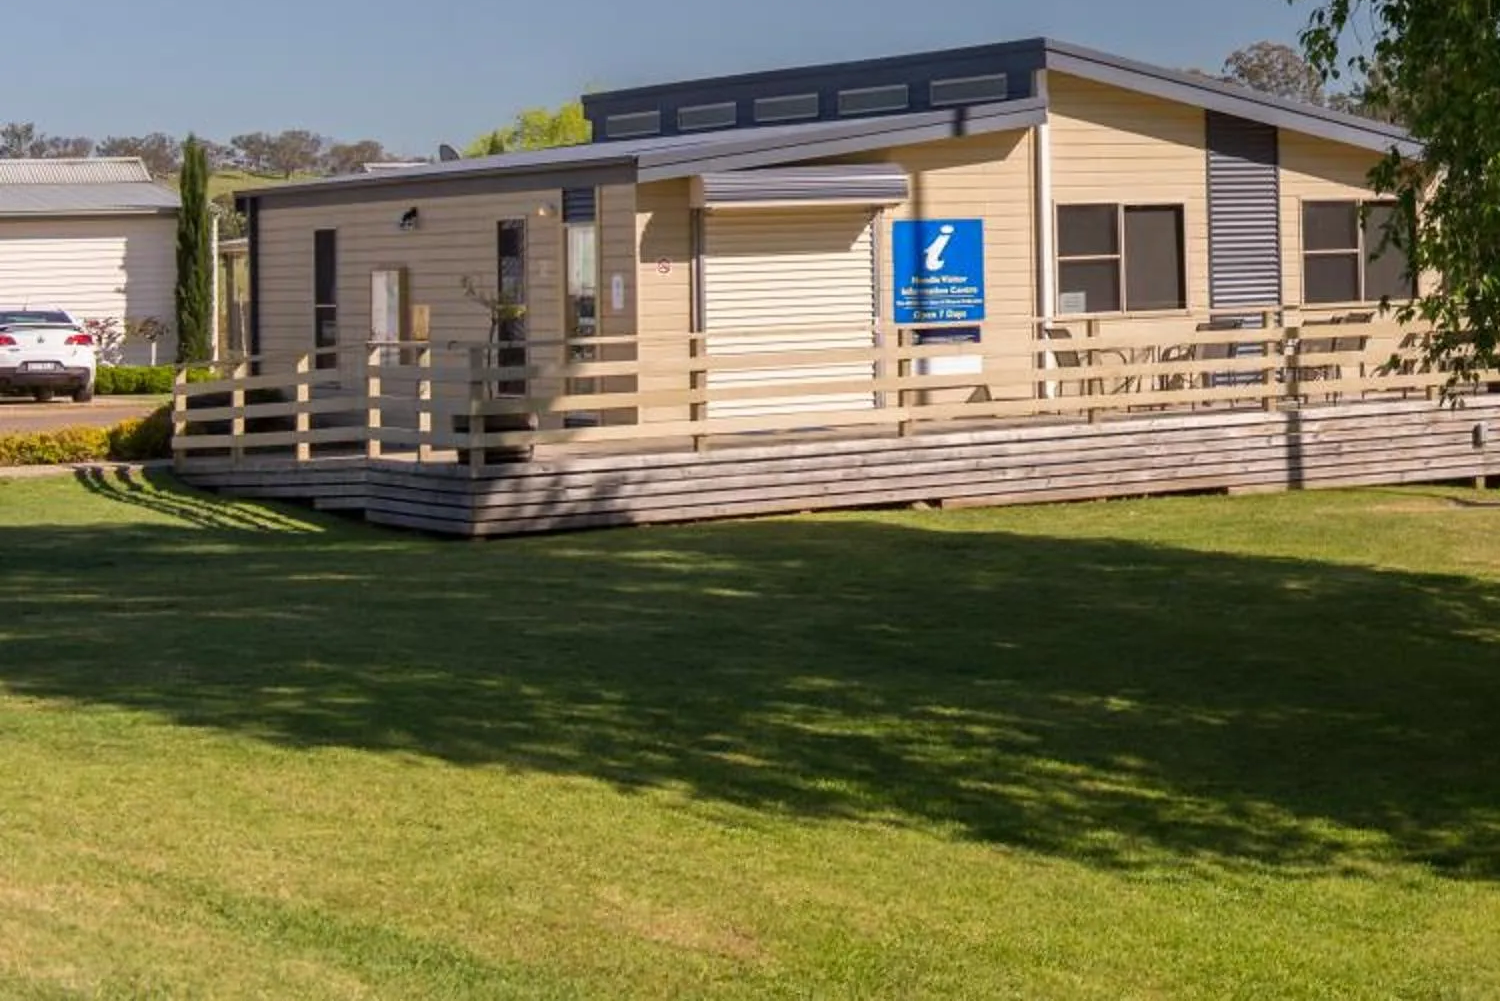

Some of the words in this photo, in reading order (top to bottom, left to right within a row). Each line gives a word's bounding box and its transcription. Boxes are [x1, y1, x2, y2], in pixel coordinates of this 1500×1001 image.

[901, 286, 949, 296] Information
[950, 286, 978, 294] Centre
[913, 310, 937, 320] Open
[945, 309, 968, 320] Days
